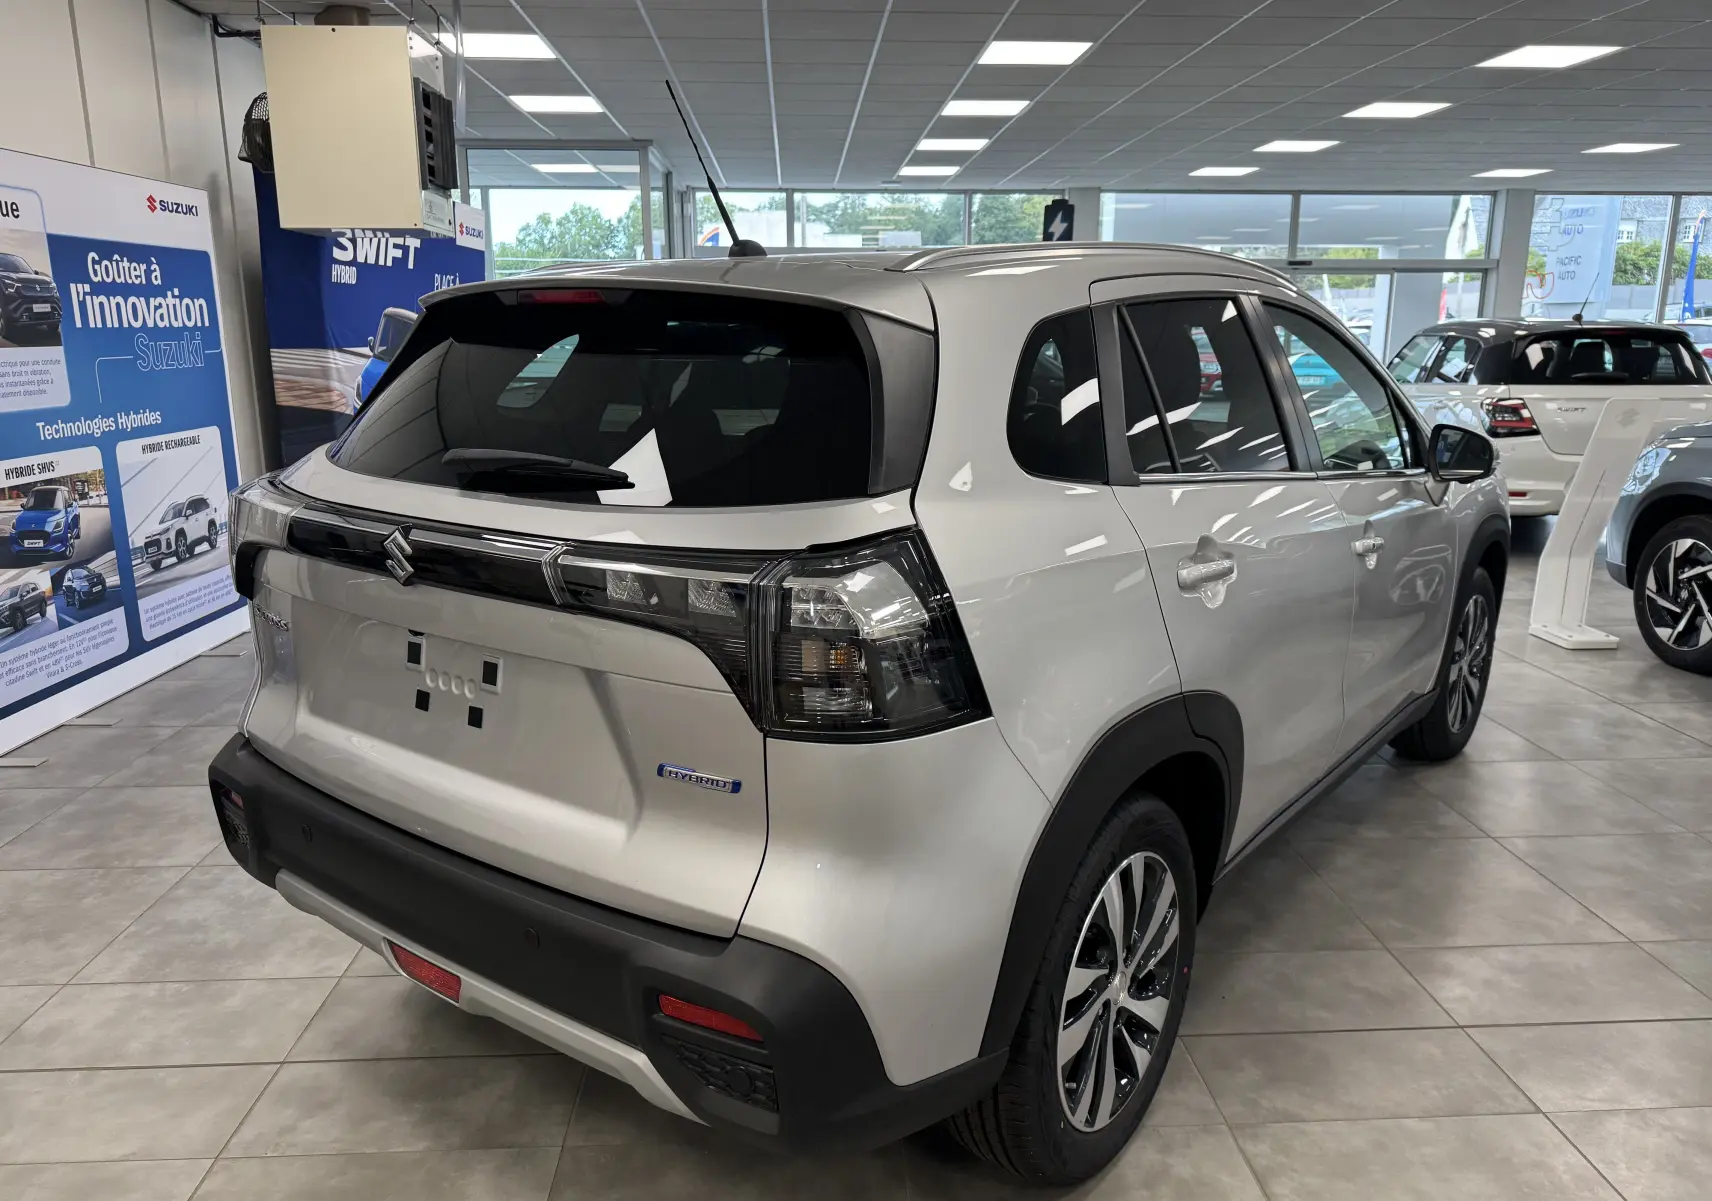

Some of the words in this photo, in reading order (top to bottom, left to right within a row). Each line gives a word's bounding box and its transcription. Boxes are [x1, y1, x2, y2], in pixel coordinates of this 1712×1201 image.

[158, 199, 199, 217] SUZUKI
[465, 225, 485, 240] SUZUKI
[332, 237, 421, 270] SWIFT
[87, 251, 147, 285] Goûter
[150, 256, 162, 286] à
[331, 263, 357, 285] HYBRID
[434, 272, 454, 291] PLACE
[69, 282, 210, 329] l'innovation
[134, 331, 205, 372] Suzuki
[36, 414, 116, 441] Technologies
[118, 408, 162, 432] Hybrides
[141, 440, 164, 455] HYBRIDE
[164, 434, 201, 451] RECHARGEABLE
[4, 463, 36, 481] HYBRIDE
[36, 460, 56, 475] SHVS
[667, 770, 727, 788] HYBRID
